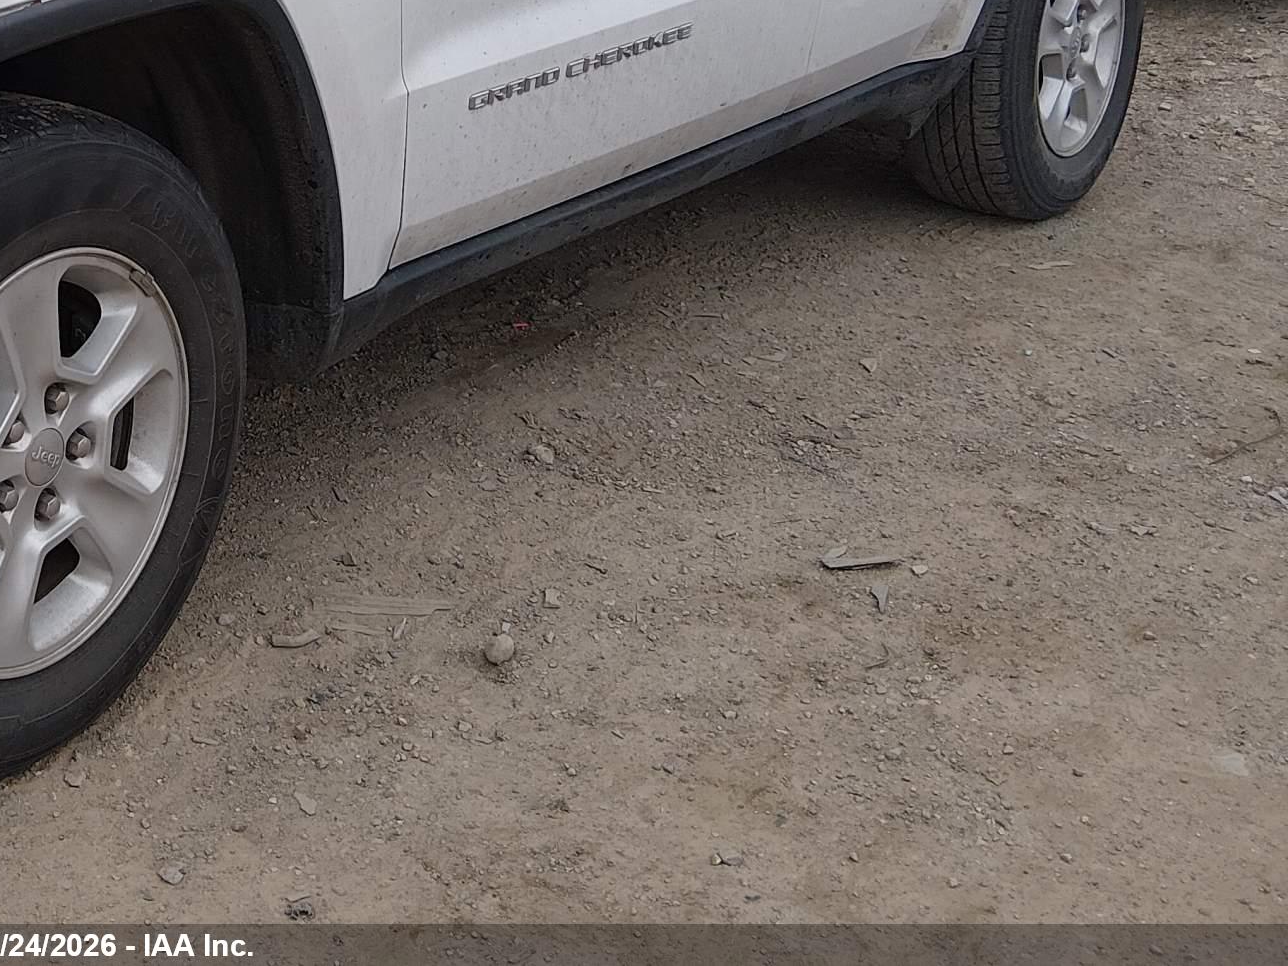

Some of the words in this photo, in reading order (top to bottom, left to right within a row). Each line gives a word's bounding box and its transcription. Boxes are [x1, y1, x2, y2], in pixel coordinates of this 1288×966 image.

[468, 66, 561, 111] GRAND
[565, 20, 695, 78] CHEROKEE
[31, 445, 62, 469] Jeep
